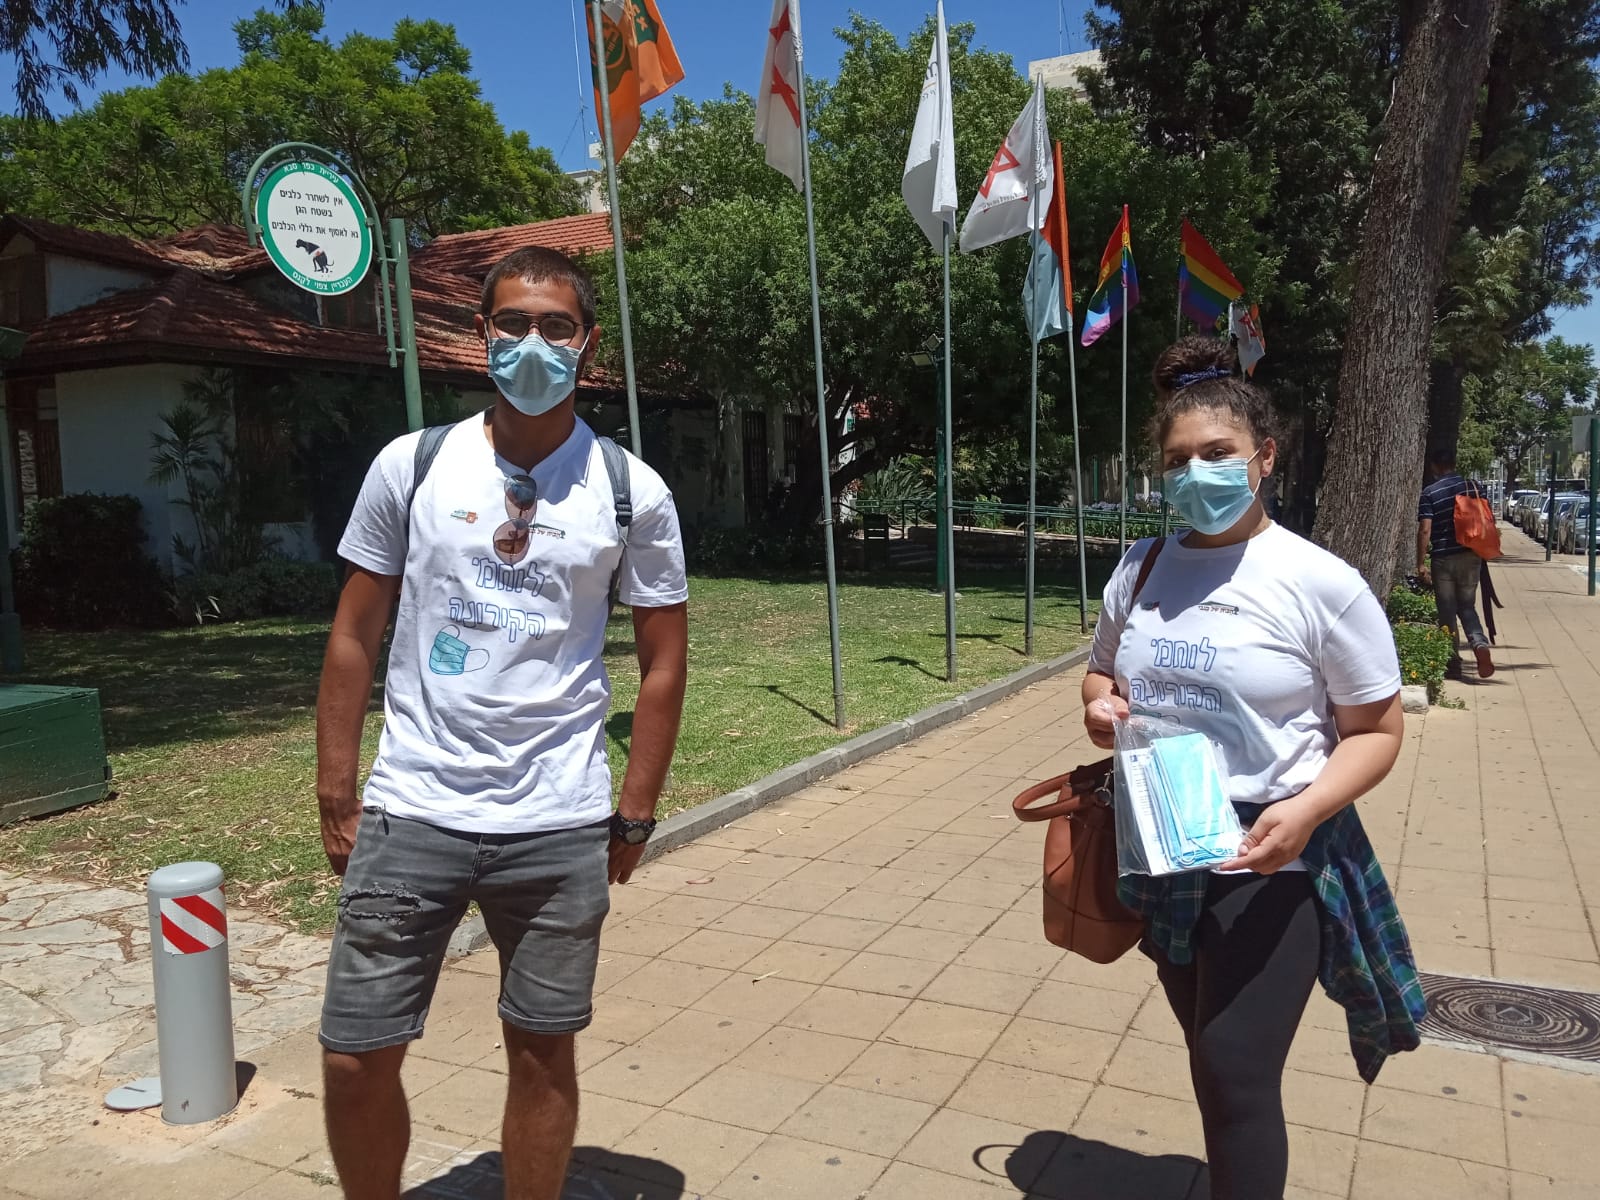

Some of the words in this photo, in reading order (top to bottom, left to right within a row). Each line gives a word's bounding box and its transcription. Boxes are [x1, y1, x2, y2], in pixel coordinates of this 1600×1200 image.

[283, 162, 298, 173] סבא
[301, 162, 315, 171] כפר
[320, 167, 339, 183] עיריית
[279, 189, 302, 199] כלבים
[305, 193, 330, 203] לשחרר
[333, 196, 344, 206] אין
[295, 205, 307, 215] הגן
[311, 207, 333, 217] בשטח
[271, 220, 296, 231] הכלבים
[298, 223, 313, 233] גללי
[315, 226, 326, 235] את
[329, 227, 348, 238] לאסוף
[351, 230, 359, 238] נא
[292, 271, 311, 286] לקנס
[314, 281, 328, 291] צפוי
[330, 276, 353, 292] העבריין
[471, 557, 546, 598] לוחמי
[449, 597, 546, 642] הקורונה
[1150, 637, 1217, 672] לוחמי
[1130, 678, 1222, 713] הקורונה
